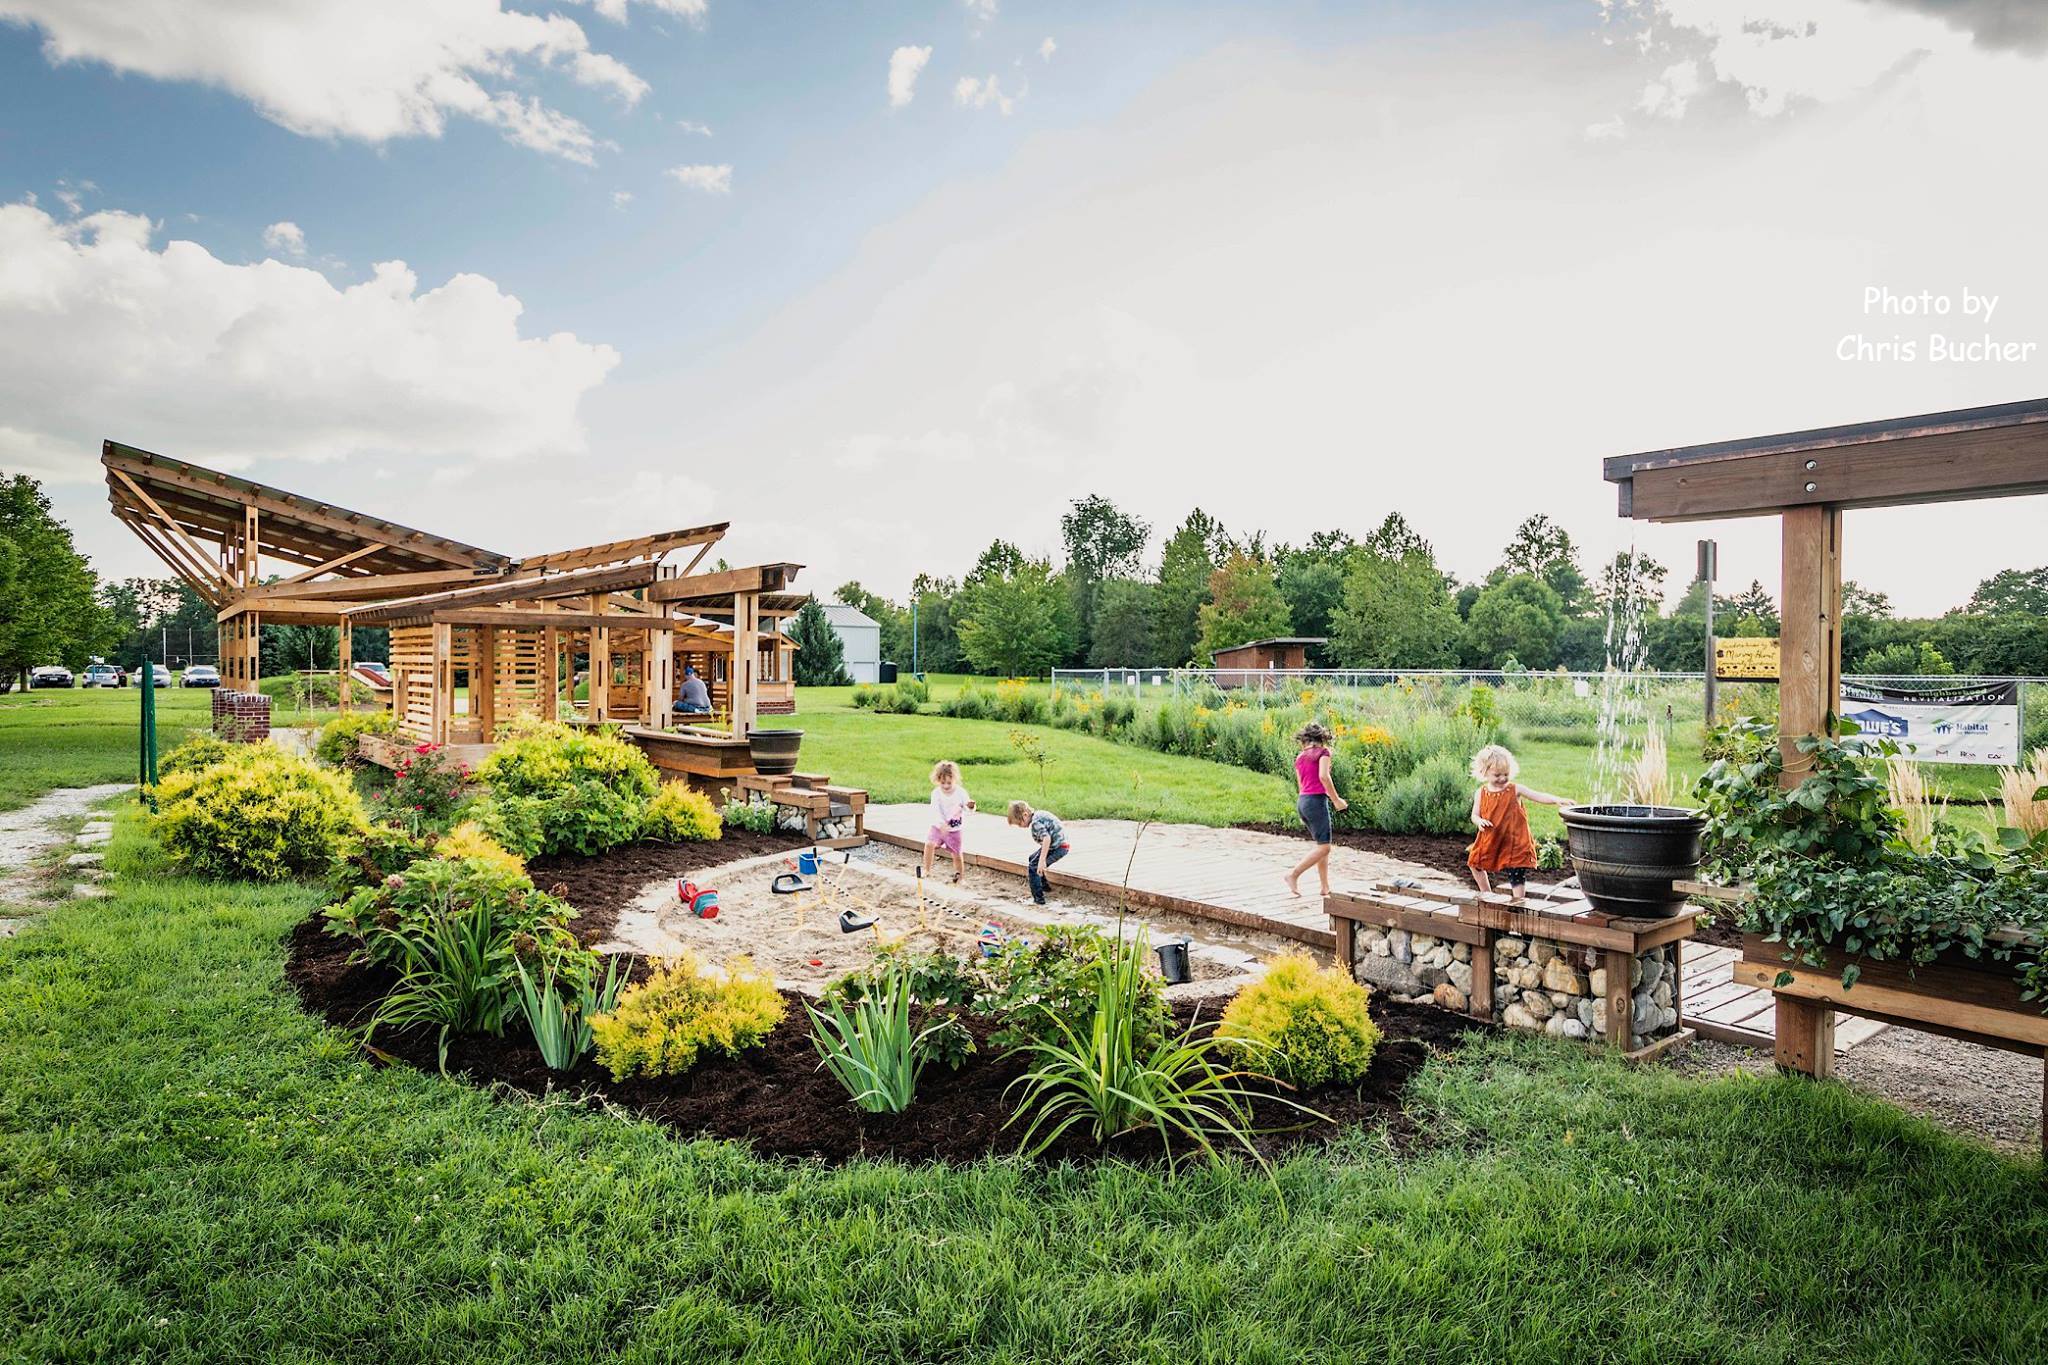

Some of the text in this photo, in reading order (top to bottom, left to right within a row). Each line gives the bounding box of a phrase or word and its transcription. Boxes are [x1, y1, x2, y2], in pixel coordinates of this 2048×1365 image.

[1903, 694, 2005, 703] REVITALIZATION
[1855, 719, 1902, 735] OWE'S
[1956, 722, 1989, 731] Habitat
